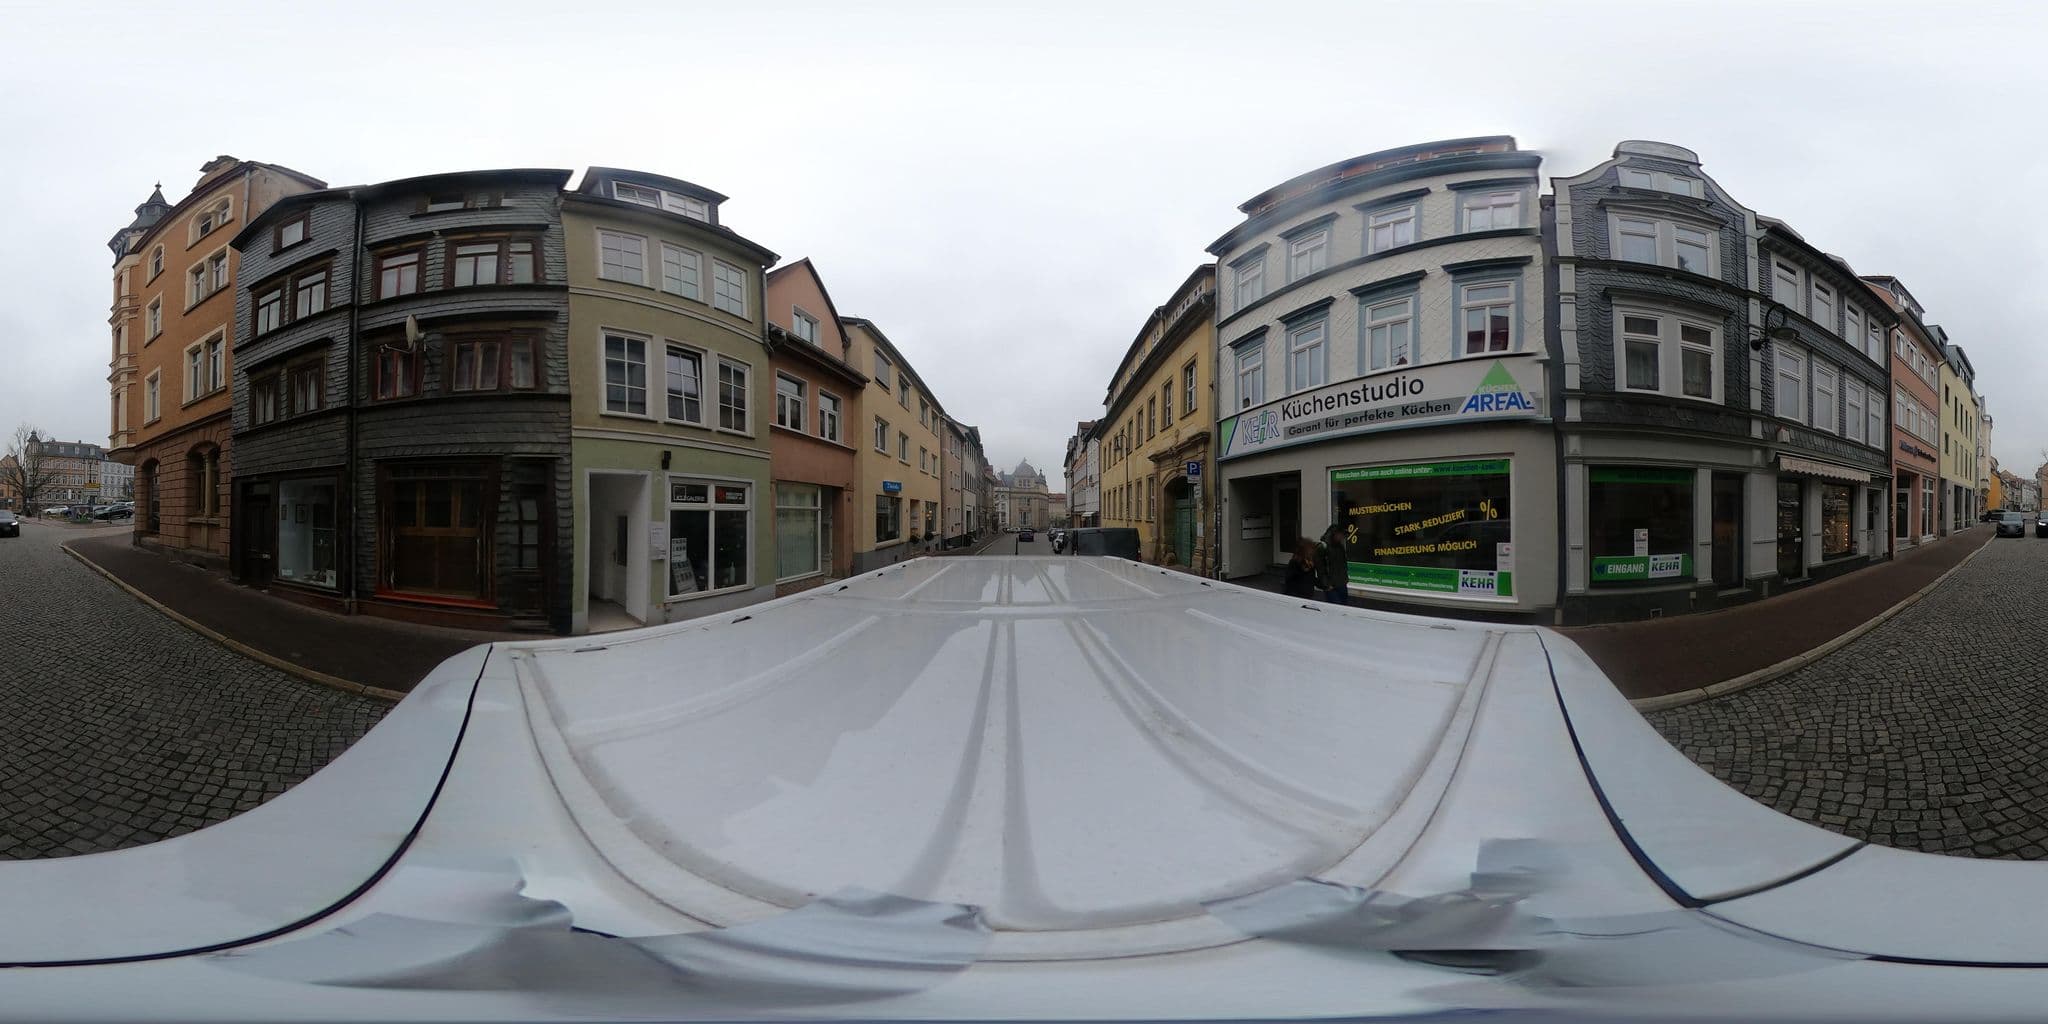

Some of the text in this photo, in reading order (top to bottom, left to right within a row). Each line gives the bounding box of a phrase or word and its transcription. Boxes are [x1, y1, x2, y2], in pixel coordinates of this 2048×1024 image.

[1281, 375, 1424, 422] Küchenstudio
[1461, 391, 1536, 414] AREAL
[1288, 402, 1451, 436] Garant für perfekte Küchen
[1241, 409, 1280, 445] KEHR
[1190, 462, 1198, 474] P
[1380, 468, 1393, 476] auch
[1348, 502, 1412, 516] MUSTERKÜCHEN
[1394, 509, 1465, 536] STARK REDUZIERT
[1374, 540, 1477, 557] FINANZIERUNG MÖGLICH
[1607, 563, 1645, 574] EINGANG
[1651, 561, 1680, 572] KEHR
[1461, 577, 1494, 589] KEHR
